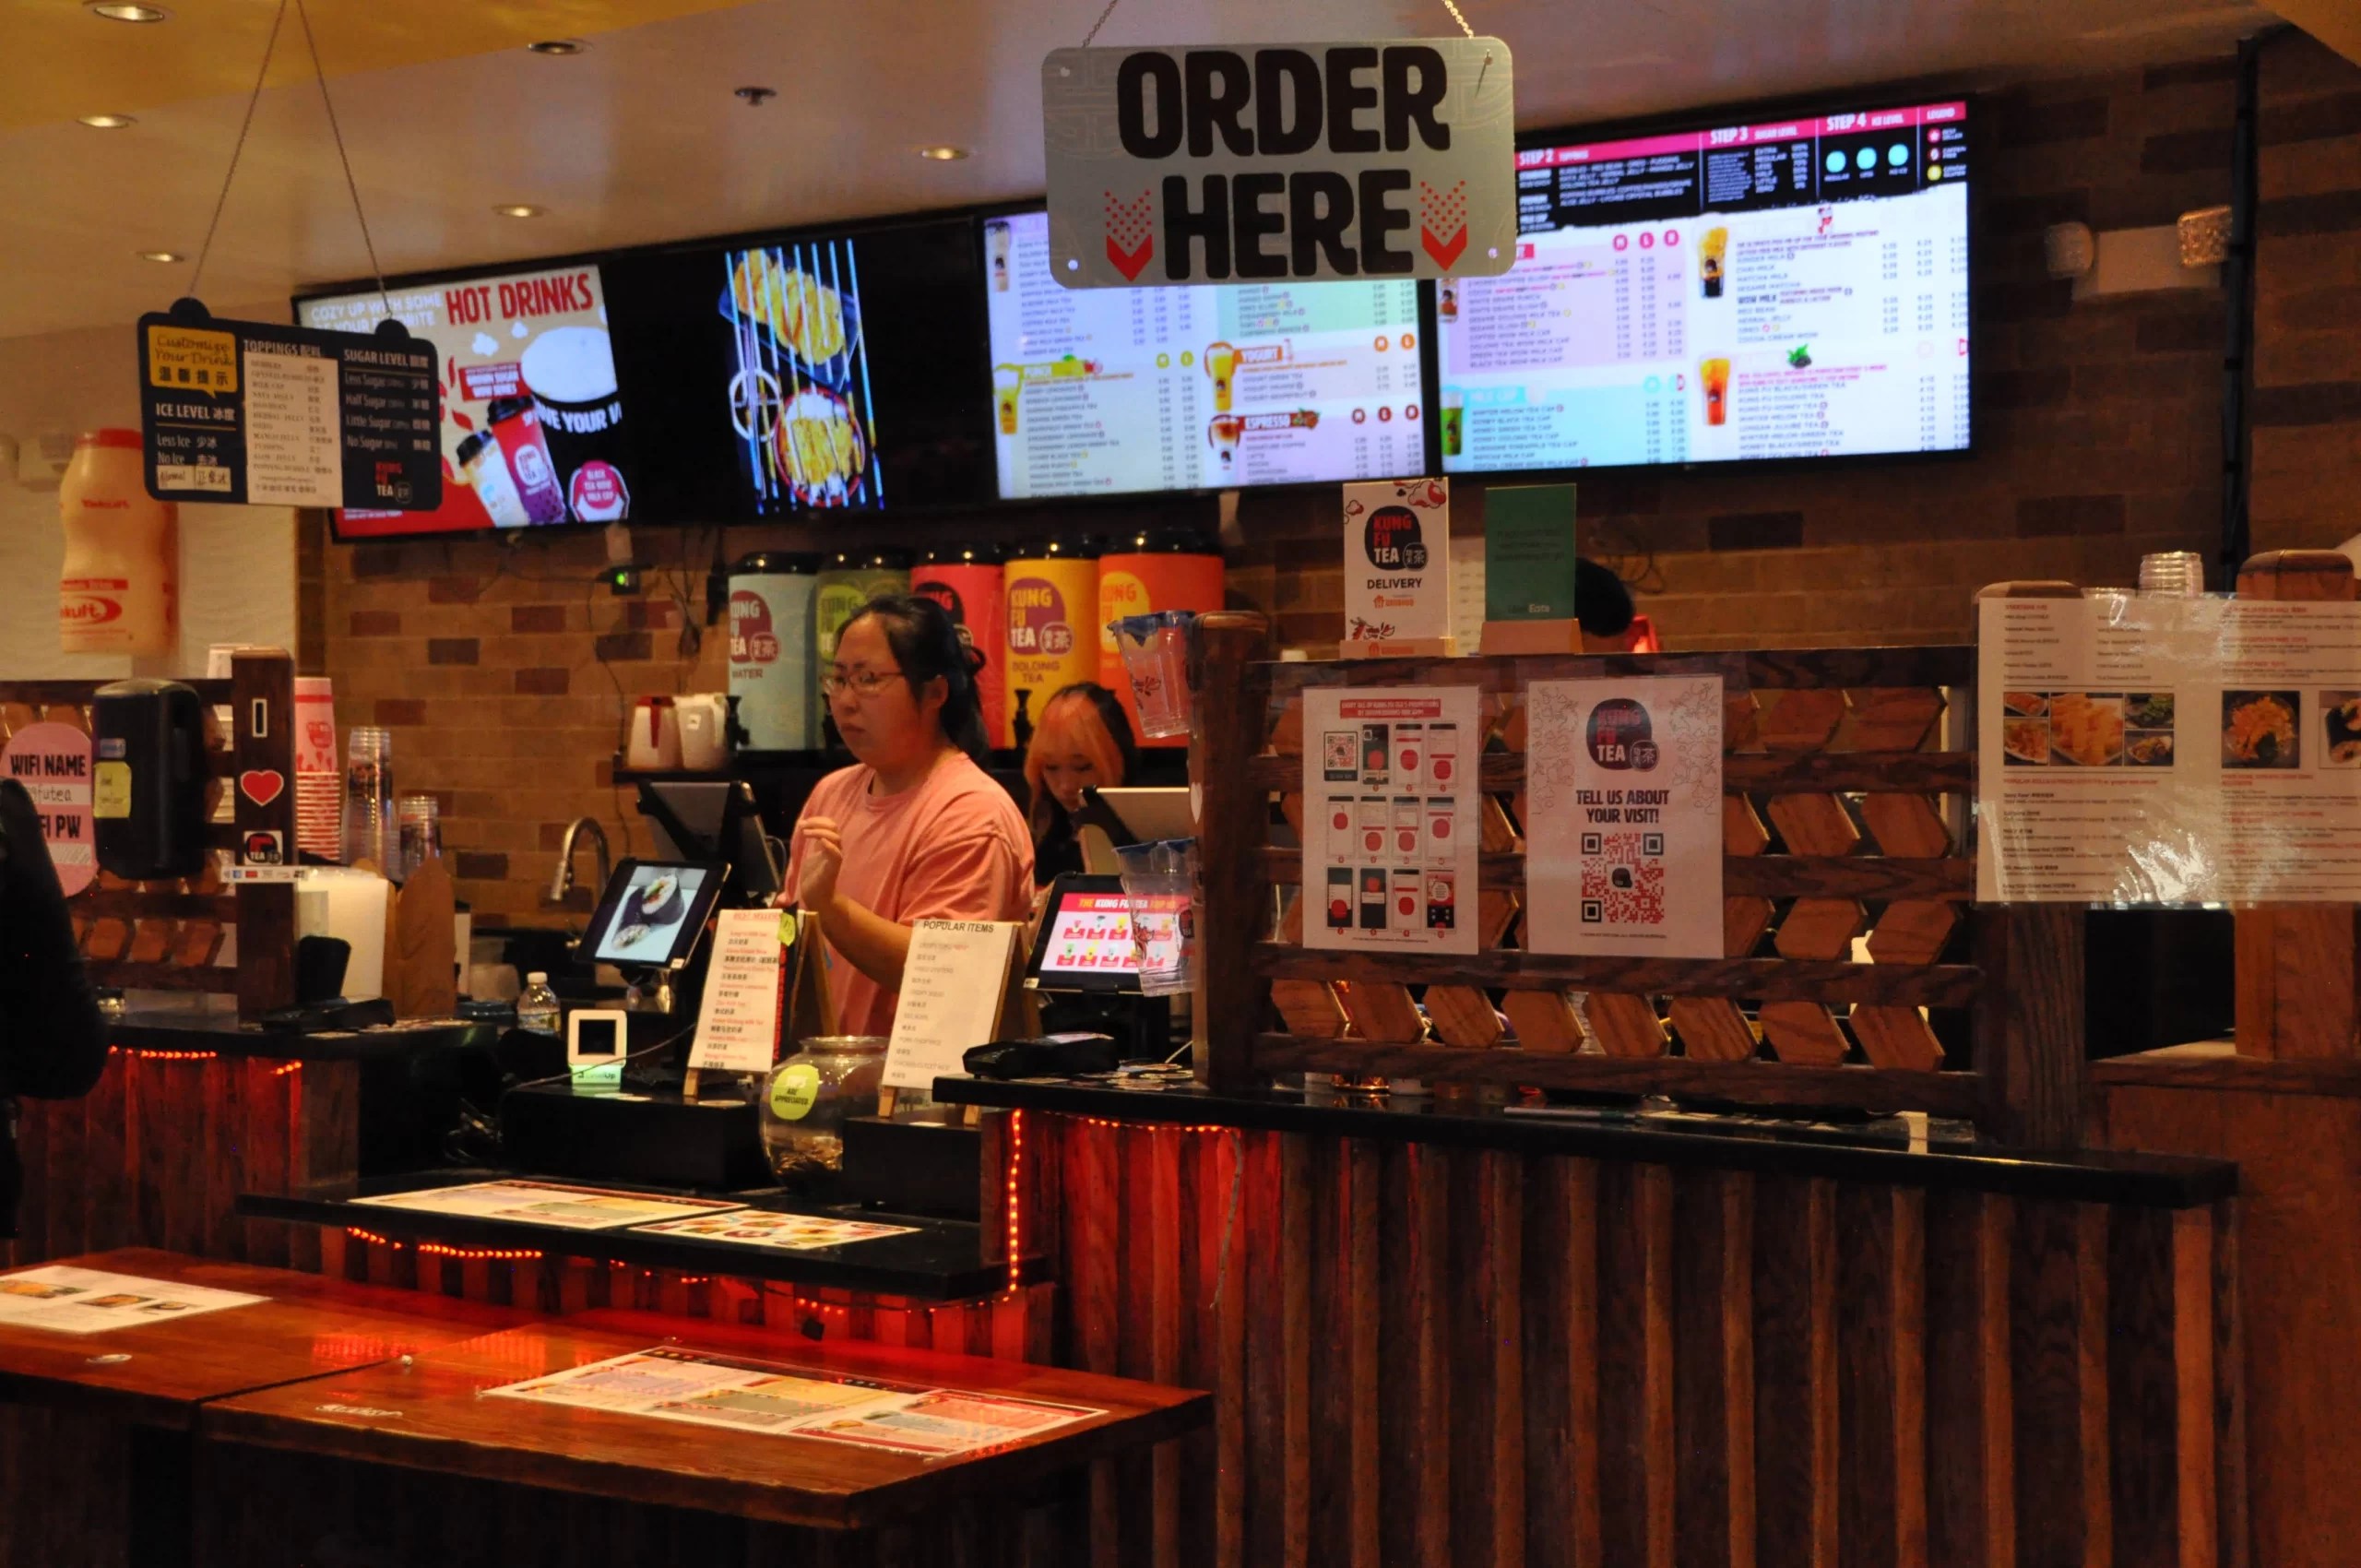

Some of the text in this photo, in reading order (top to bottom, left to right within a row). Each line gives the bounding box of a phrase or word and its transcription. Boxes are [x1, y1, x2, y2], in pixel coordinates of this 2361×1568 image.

[1117, 46, 1451, 158] ORDER
[1827, 113, 1856, 131] STEP
[1857, 113, 1867, 126] 4
[1883, 113, 1904, 125] LEVEL
[1711, 127, 1738, 145] STEP
[1739, 125, 1748, 141] 3
[1519, 150, 1544, 166] STEP
[1546, 148, 1554, 163] 2
[1162, 170, 1414, 280] HERE
[445, 273, 594, 326] HOT DRINKS
[243, 339, 298, 355] TOPPINGS
[344, 349, 409, 366] SUGAR LEVEL
[156, 403, 173, 417] ICE
[177, 404, 210, 419] LEVEL
[561, 409, 608, 434] YOUR
[157, 433, 175, 446] Less
[177, 434, 191, 447] Ice
[158, 452, 171, 466] No
[376, 484, 394, 496] TEA
[1373, 515, 1412, 531] KUNG
[1373, 532, 1391, 546] FU
[1374, 548, 1399, 564] TEA
[1367, 578, 1422, 590] DELIVERY
[1011, 588, 1052, 607] KUNG
[1011, 610, 1026, 627] FU
[1011, 628, 1036, 647] TEA
[731, 668, 764, 680] WATER
[1022, 673, 1044, 683] TEA
[1597, 708, 1642, 727] KUNG
[1597, 728, 1617, 744] FU
[1596, 744, 1626, 762] TEA
[10, 754, 87, 777] WIFI NAME
[1576, 790, 1669, 805] TELL US ABOUT
[1586, 808, 1659, 824] YOUR VISIT!
[55, 814, 81, 838] PW
[1079, 898, 1095, 908] THE
[1095, 898, 1119, 908] KUNG
[923, 921, 994, 932] POPULAR ITEMS
